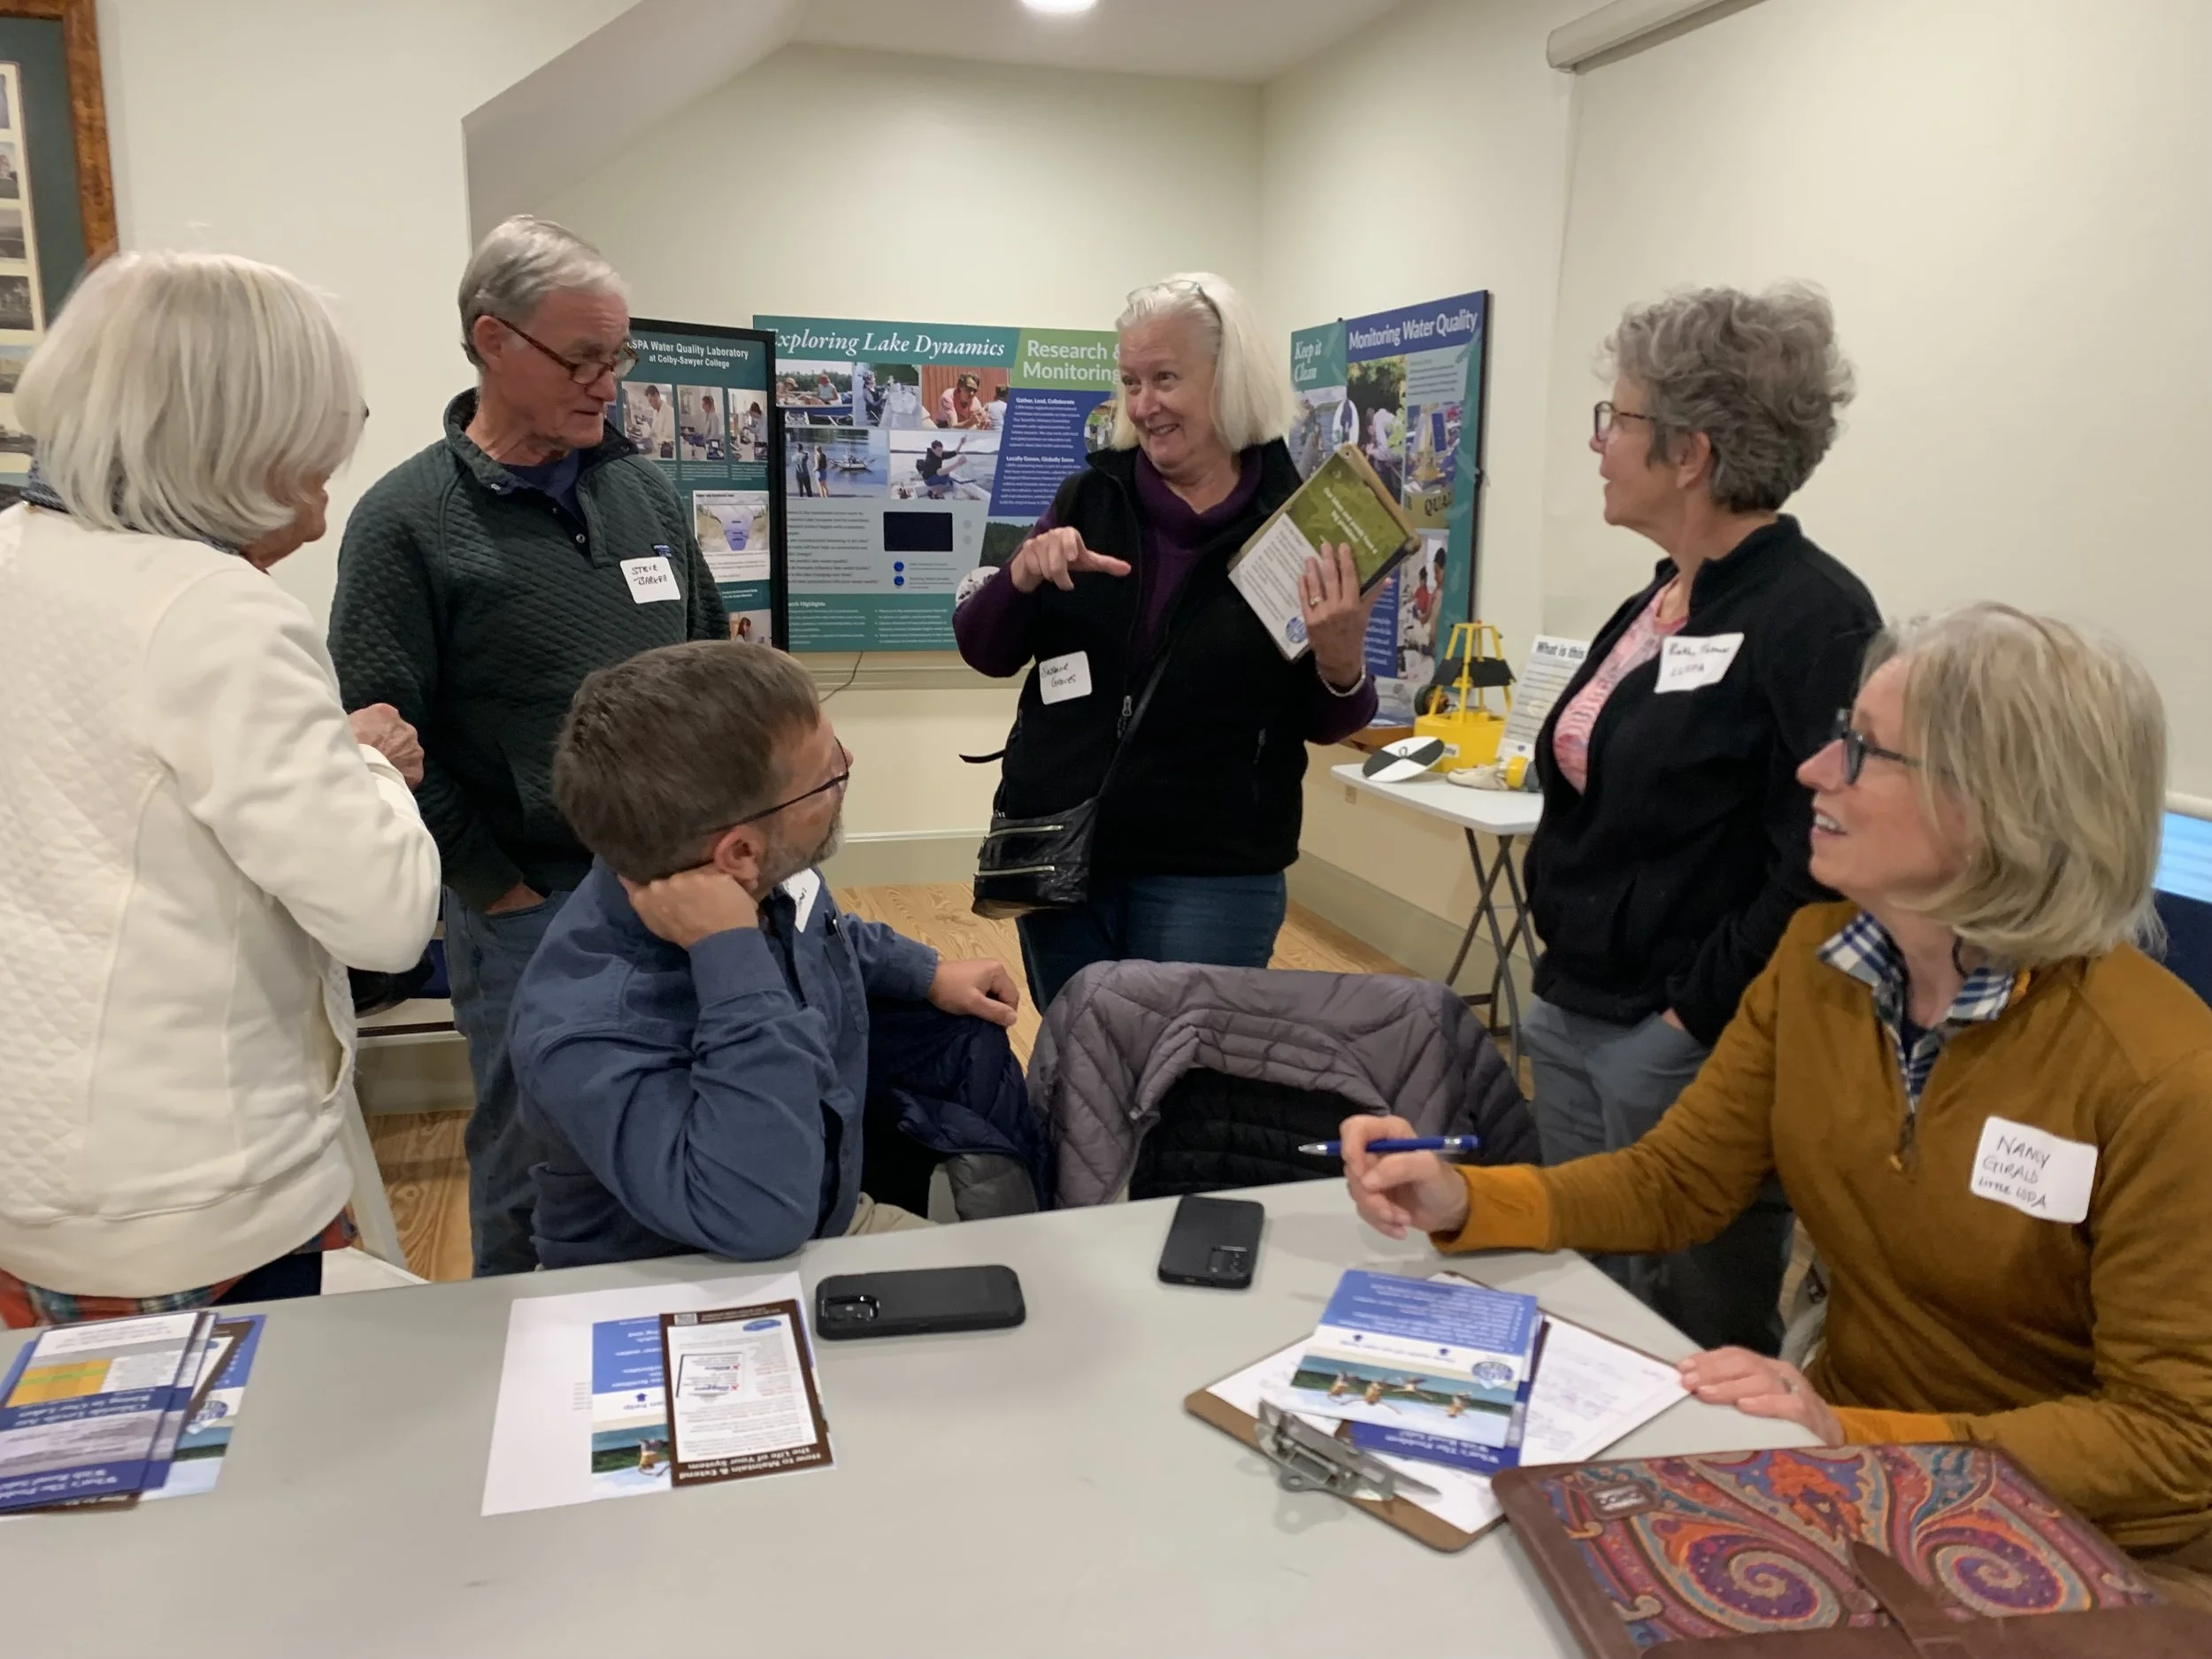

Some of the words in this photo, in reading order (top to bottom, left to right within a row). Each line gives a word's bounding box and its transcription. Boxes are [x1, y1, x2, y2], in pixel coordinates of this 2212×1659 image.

[1348, 324, 1401, 350] Monitoring
[1402, 319, 1434, 340] Water
[1436, 309, 1478, 336] Quality
[650, 341, 673, 352] Water
[677, 343, 704, 357] Quality
[707, 346, 749, 360] Laboratory
[862, 332, 909, 352] Lake
[913, 334, 1004, 359] Dynamics
[1027, 340, 1108, 360] Research
[1294, 341, 1314, 364] Keep
[657, 355, 703, 367] Colby-Sawyer
[704, 357, 730, 369] College
[1023, 361, 1121, 385] Monitoring
[1294, 362, 1317, 382] Clean
[632, 565, 658, 575] STEVE
[1536, 641, 1557, 656] What
[1558, 644, 1566, 657] is
[771, 1450, 789, 1459] Life
[792, 1447, 810, 1455] the
[796, 1453, 821, 1462] How
[687, 1460, 727, 1469] System
[730, 1456, 755, 1465] Your
[731, 1461, 780, 1472] Maintain
[679, 1469, 718, 1480] Extend
